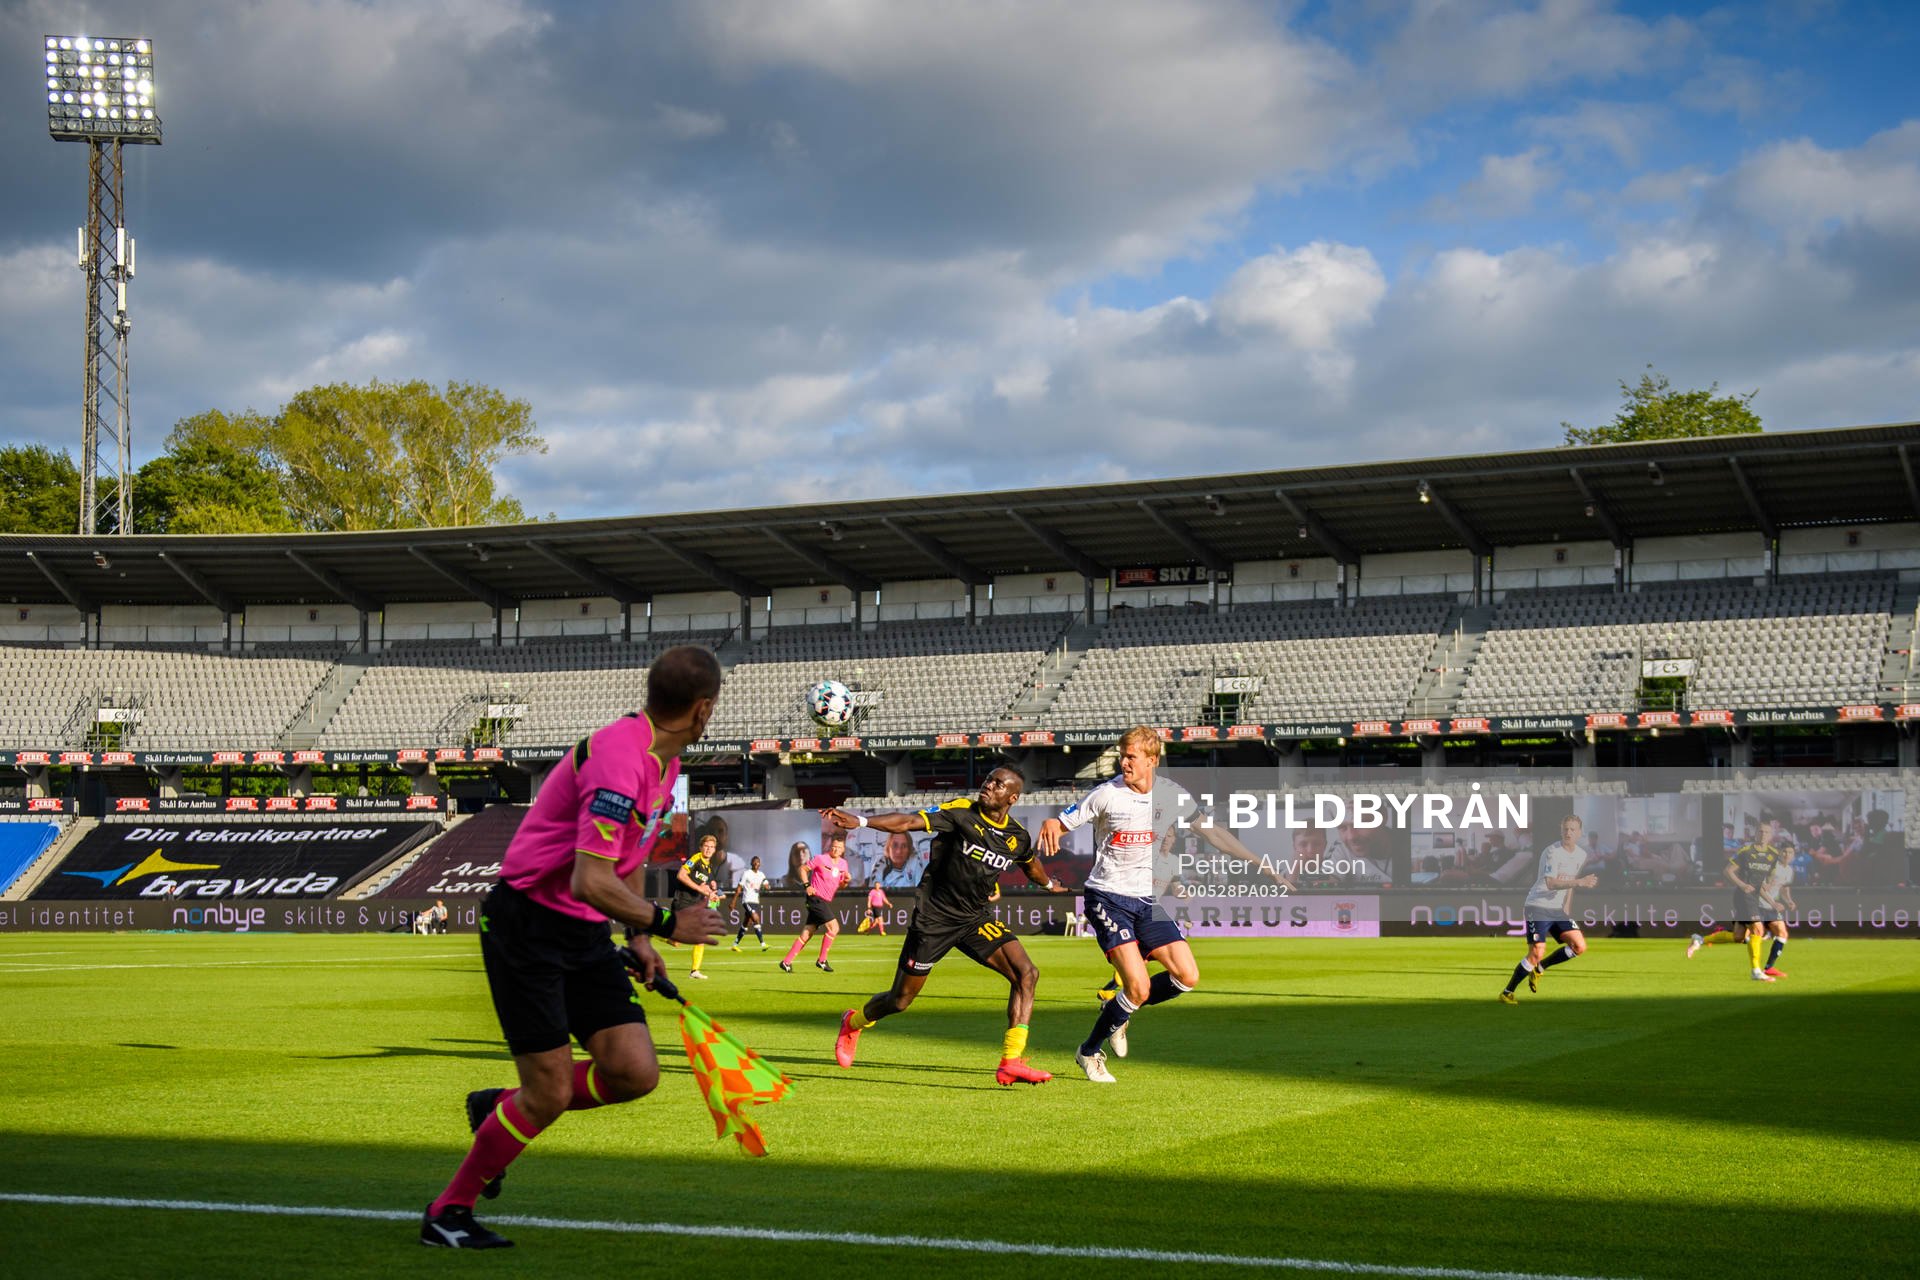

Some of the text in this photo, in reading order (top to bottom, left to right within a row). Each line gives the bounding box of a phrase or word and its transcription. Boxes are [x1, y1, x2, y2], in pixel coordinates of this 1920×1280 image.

[1159, 567, 1191, 582] SKY
[1662, 663, 1679, 673] C5
[1232, 680, 1246, 690] C6
[1747, 710, 1824, 722] Skål for Aarhus
[1846, 707, 1875, 716] CERES
[1593, 716, 1619, 724] CERES
[1645, 714, 1672, 722] CERES
[1698, 712, 1726, 721] CERES
[1360, 723, 1384, 732] CERES
[1408, 721, 1433, 730] CERES
[1456, 720, 1482, 728] CERES
[1502, 718, 1573, 729] Skål for Aarhus
[1188, 728, 1211, 736] CERES
[1234, 727, 1256, 736] CERES
[1275, 725, 1342, 736] Skål for Aarhus
[942, 736, 964, 744] CERES
[984, 734, 1005, 742] CERES
[1026, 733, 1048, 741] CERES
[1064, 732, 1122, 742] Skål for Aarhu
[756, 741, 776, 749] CERES
[795, 740, 816, 748] CERES
[868, 738, 926, 747] Skål for Aarhus
[686, 743, 741, 752] Skål for Aarhus
[22, 752, 44, 760] CERES
[66, 752, 87, 760] CERES
[108, 752, 130, 760] CERES
[145, 754, 162, 762] Skål
[164, 754, 174, 762] for
[218, 752, 238, 760] CERES
[260, 752, 279, 760] CERES
[300, 752, 318, 760] CERES
[334, 753, 350, 761] Skål
[402, 751, 422, 759] CERES
[512, 750, 564, 758] Skål for Aarhus
[160, 800, 216, 808] Skål for Aarhus
[346, 799, 400, 808] Skål for Aarhus
[412, 798, 432, 806] CERES
[124, 828, 388, 844] Din teknikpartner
[1120, 832, 1152, 843] CERES
[139, 872, 339, 897] bravida
[31, 907, 135, 925] identitet
[173, 902, 266, 932] nonbye
[284, 906, 345, 926] skilte
[358, 906, 369, 925] &
[730, 904, 1055, 926] silte visue titet
[1410, 899, 1527, 936] nonby
[1584, 904, 1679, 928] skilte
[1700, 904, 1716, 928] &
